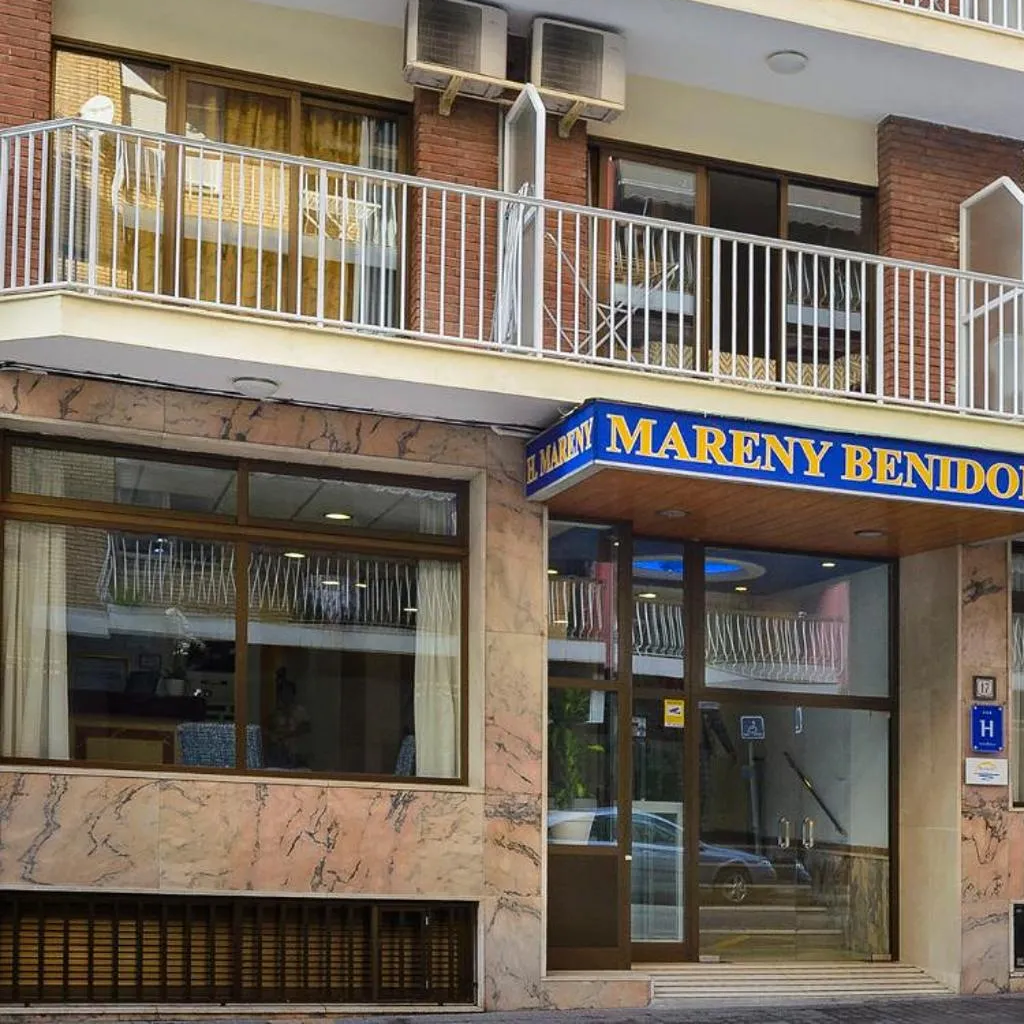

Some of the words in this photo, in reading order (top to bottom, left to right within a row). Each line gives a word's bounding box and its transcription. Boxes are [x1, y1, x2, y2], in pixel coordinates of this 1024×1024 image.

[539, 416, 594, 477] MARENY
[605, 413, 832, 478] MARENY
[980, 719, 995, 738] H
